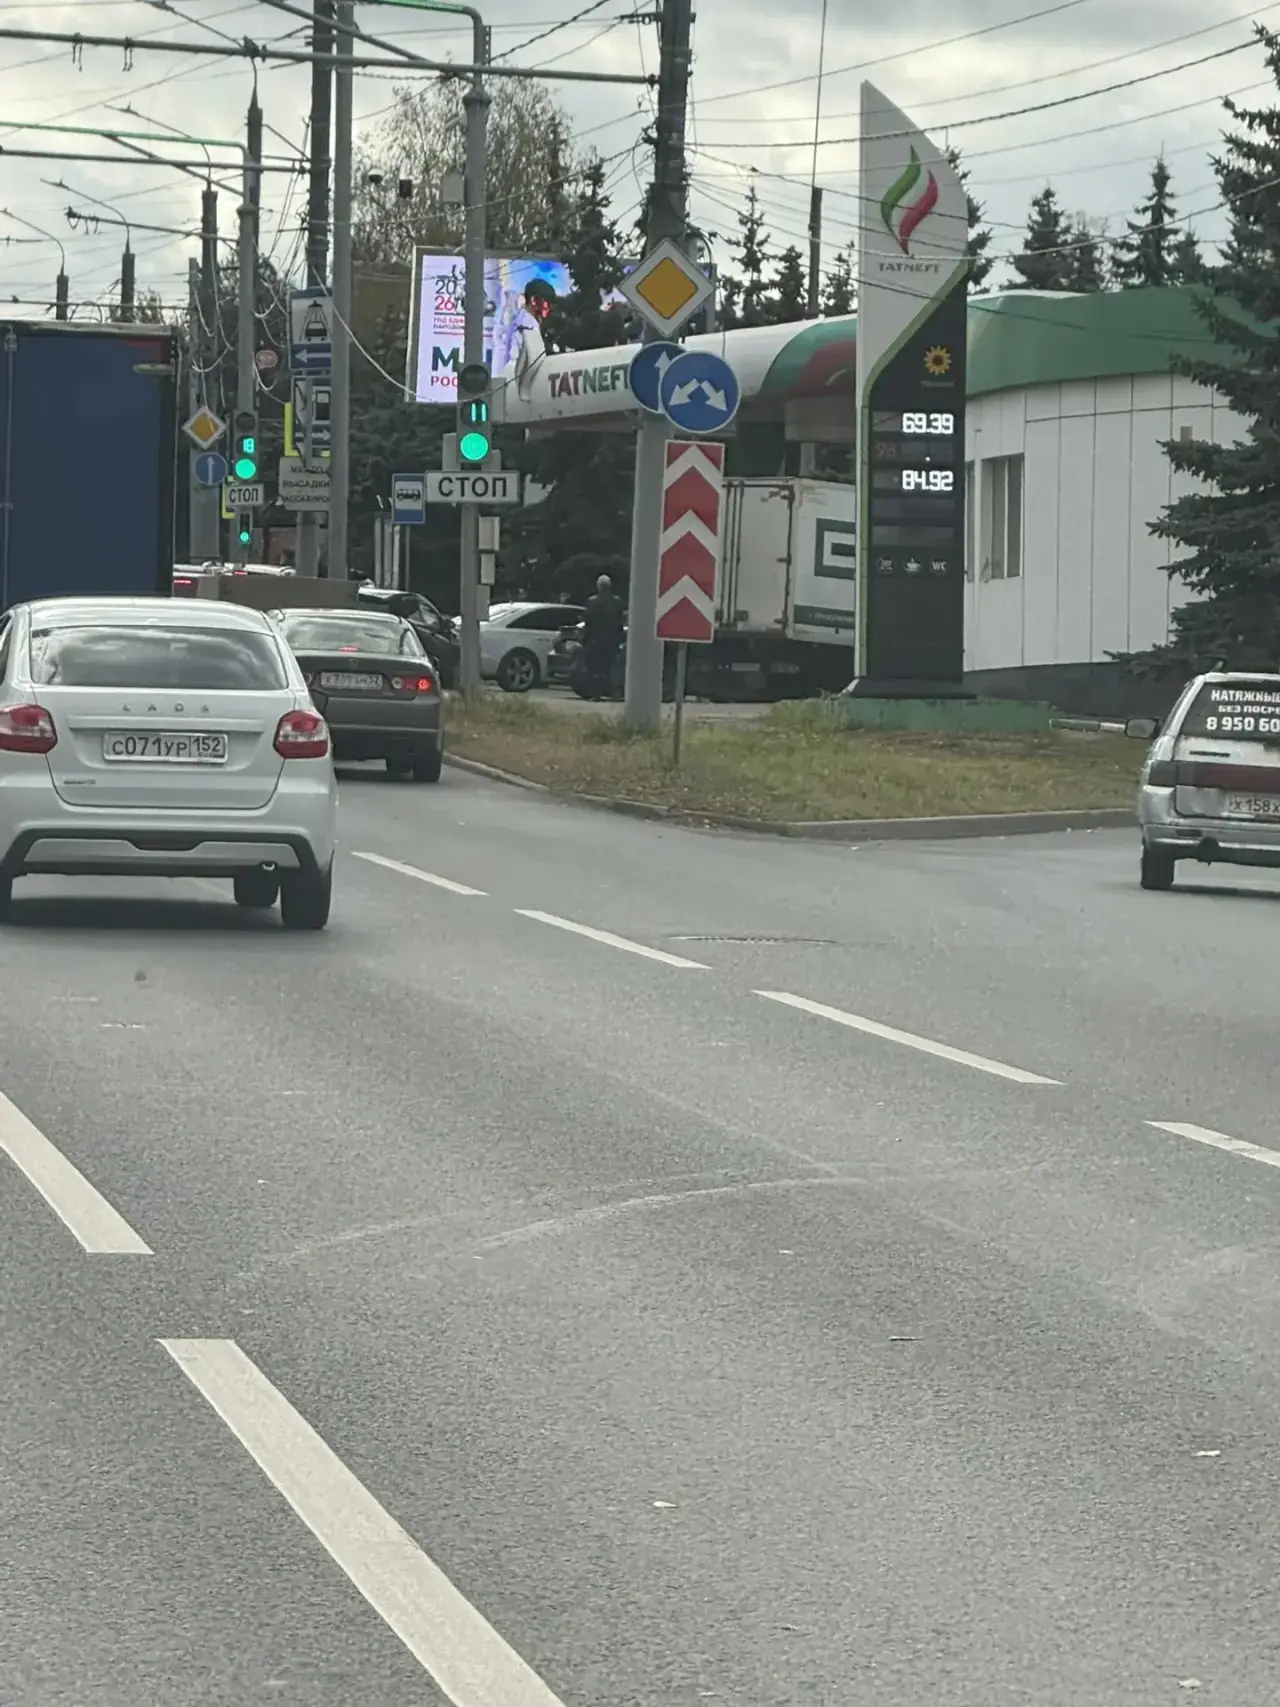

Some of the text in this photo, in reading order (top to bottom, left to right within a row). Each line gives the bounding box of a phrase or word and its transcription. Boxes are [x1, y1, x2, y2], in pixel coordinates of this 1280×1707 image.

[878, 262, 940, 274] TATNEFT
[435, 280, 457, 295] 20
[434, 296, 455, 311] 26
[902, 412, 954, 434] 69.39
[438, 476, 507, 498] СТОП
[902, 470, 954, 491] 84.92
[229, 487, 259, 503] СТОП
[931, 560, 947, 572] WC
[123, 703, 210, 713] LADA
[1206, 716, 1280, 732] 8 950 60
[192, 736, 221, 752] 152
